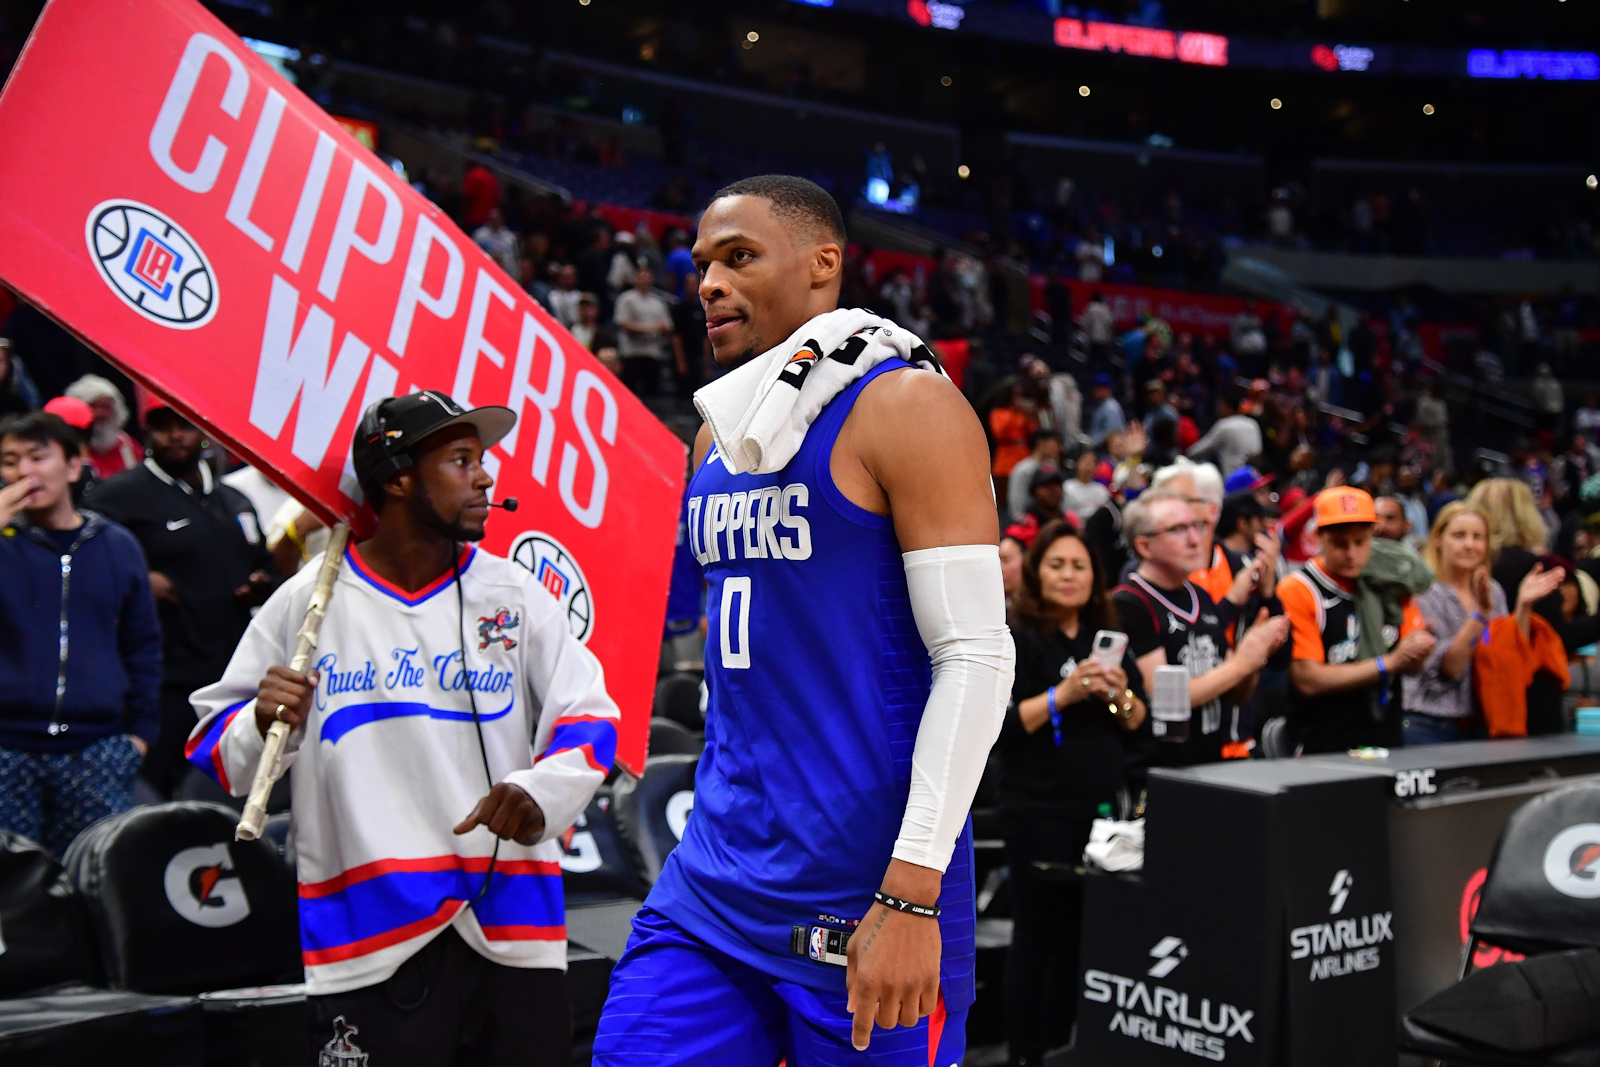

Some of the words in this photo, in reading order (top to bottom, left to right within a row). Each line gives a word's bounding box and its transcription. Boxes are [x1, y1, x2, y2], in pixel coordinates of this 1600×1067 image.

[149, 32, 618, 530] CLIPPERS
[688, 482, 813, 566] CLIPPERS
[720, 576, 751, 669] 0
[312, 653, 376, 711] Chuck
[385, 646, 425, 690] The
[433, 650, 514, 694] Condor
[1394, 768, 1437, 797] anc
[164, 842, 251, 928] G
[1290, 911, 1394, 961] STARLUX
[1309, 946, 1380, 982] AIRLINES
[1083, 969, 1255, 1043] STARLUX
[1109, 1011, 1226, 1062] AIRLINES
